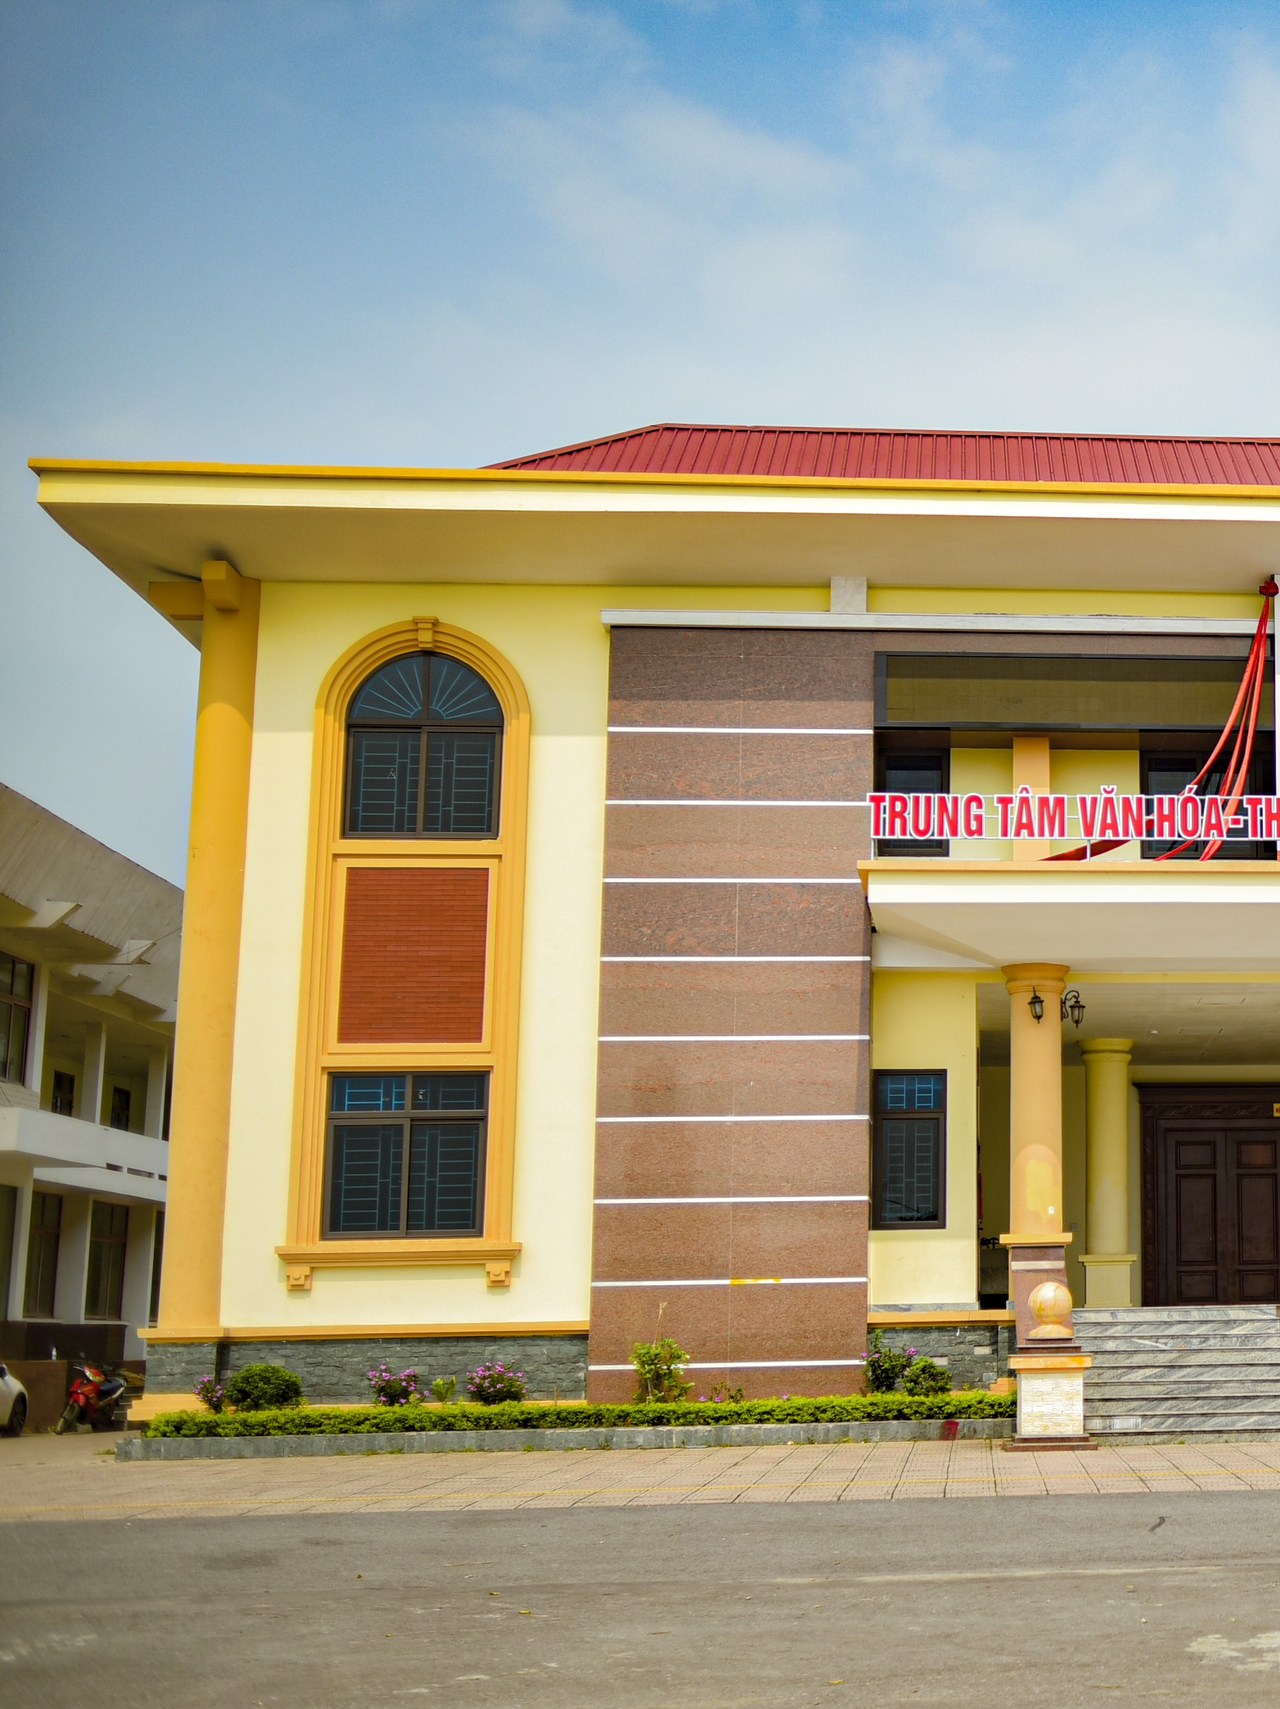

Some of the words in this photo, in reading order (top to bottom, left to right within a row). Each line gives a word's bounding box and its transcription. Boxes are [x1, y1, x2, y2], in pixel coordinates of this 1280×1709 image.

[868, 793, 984, 838] TRUNG
[997, 785, 1066, 839] TÂM
[1079, 785, 1144, 839] VĂN
